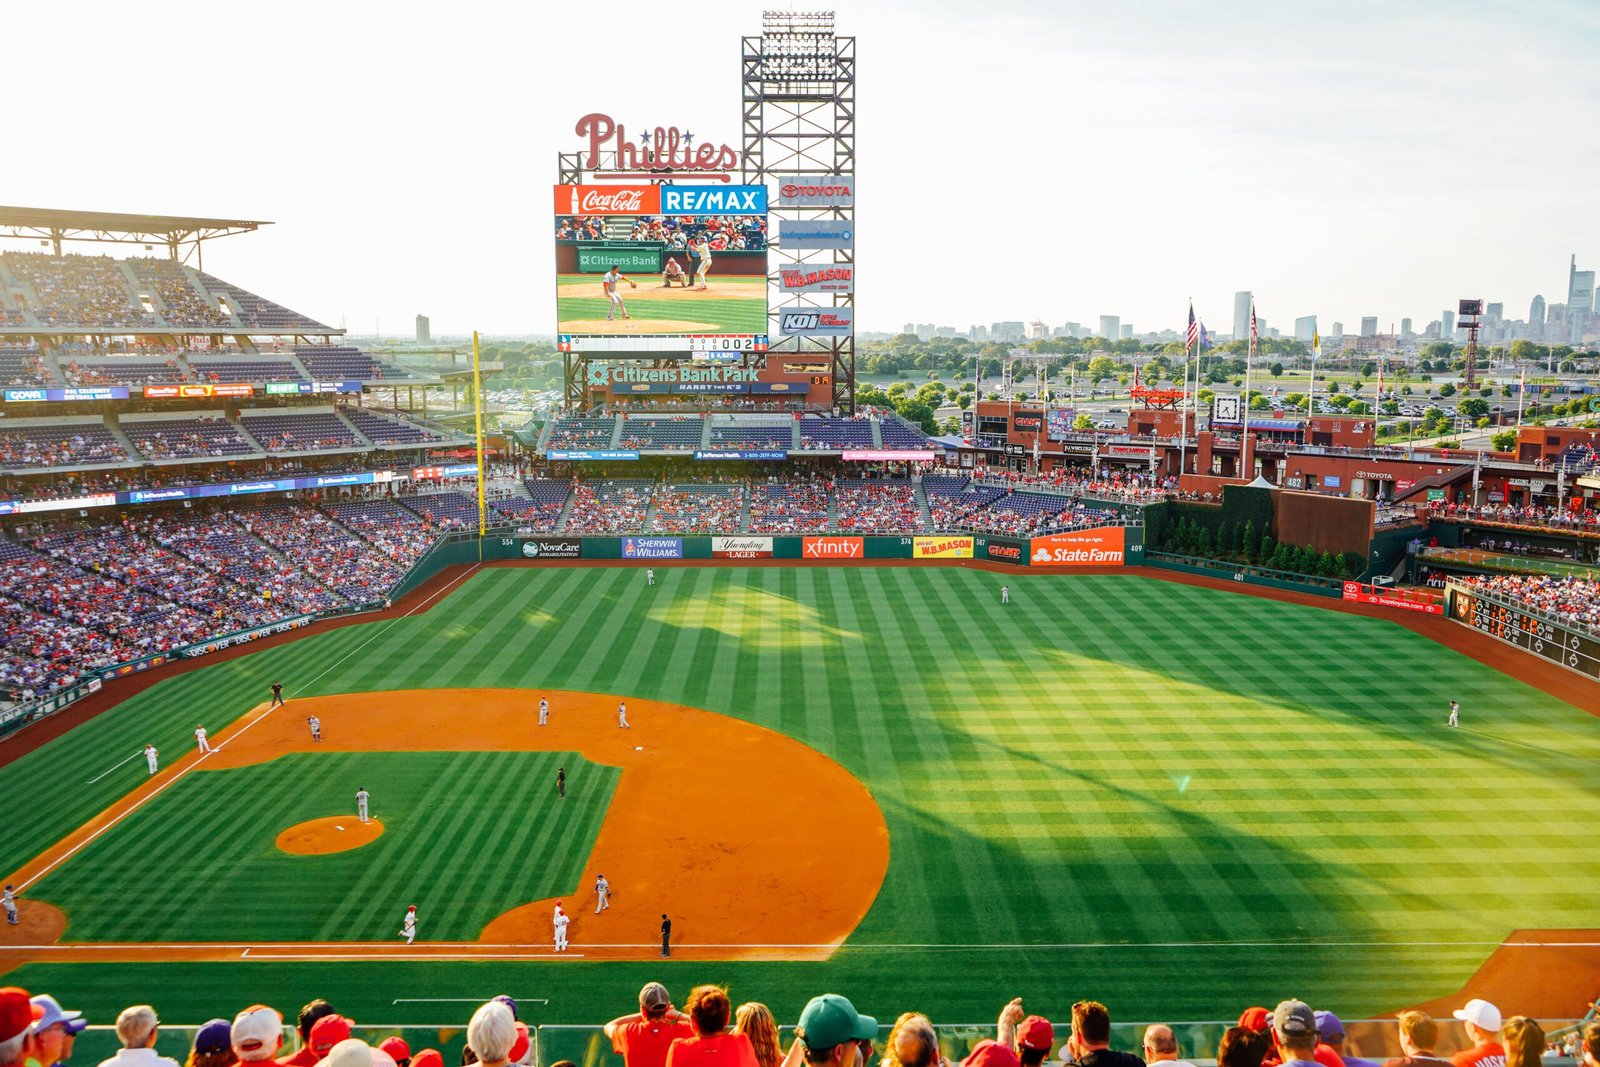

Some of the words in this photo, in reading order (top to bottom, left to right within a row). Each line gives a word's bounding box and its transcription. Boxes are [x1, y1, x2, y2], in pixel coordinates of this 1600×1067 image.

[575, 113, 737, 169] Phillies
[799, 186, 851, 196] TOYOTA
[583, 190, 644, 211] Coca-Cola
[667, 191, 757, 210] RE/MAX
[591, 255, 631, 265] Citizens
[632, 255, 656, 265] Bank
[722, 339, 729, 349] 0
[733, 339, 741, 349] 0
[745, 339, 752, 349] 2
[612, 367, 677, 382] Citizens
[679, 366, 721, 382] Bank
[723, 367, 759, 382] Park
[539, 542, 580, 552] NovaCare
[637, 539, 677, 548] SHERWIN
[719, 538, 764, 551] Yuengling
[806, 538, 860, 557] xfinity
[988, 545, 1020, 557] GIANT
[1379, 598, 1423, 609] buyatoyota.com
[275, 618, 310, 632] DISCOVER
[235, 628, 271, 645] DISCOVER
[189, 640, 229, 657] DISCOVER
